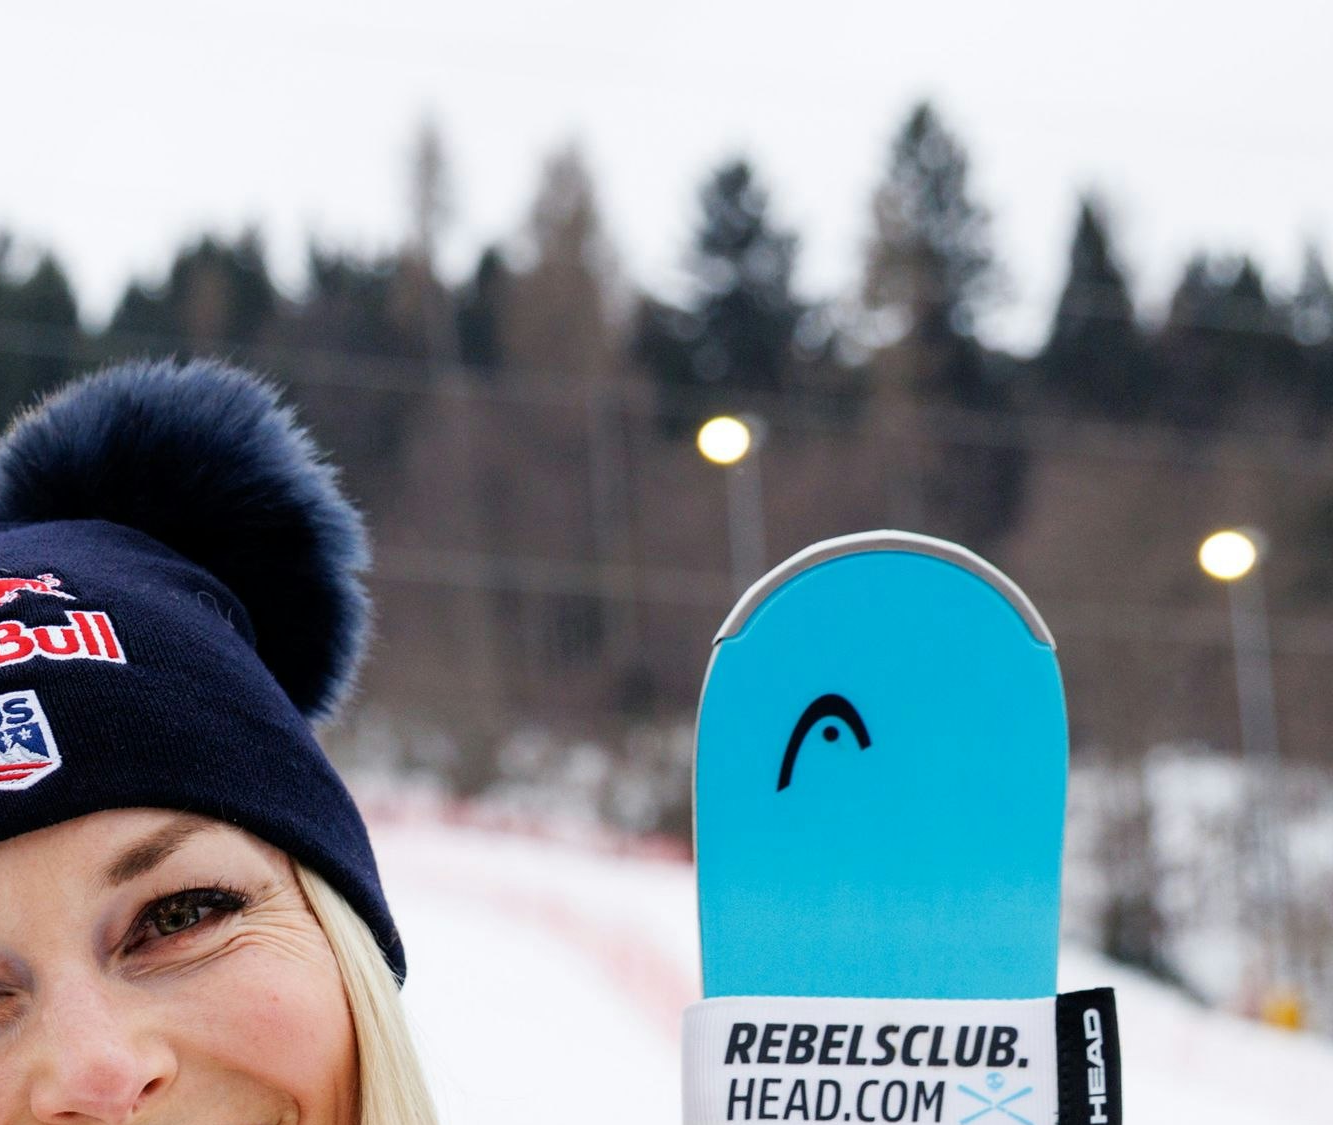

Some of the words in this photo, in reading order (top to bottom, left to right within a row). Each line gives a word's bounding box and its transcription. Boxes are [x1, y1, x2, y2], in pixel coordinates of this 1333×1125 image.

[724, 1022, 1029, 1068] REBELSCLUB.
[1083, 1006, 1109, 1125] HEAD
[727, 1078, 945, 1123] HEAD.COM
